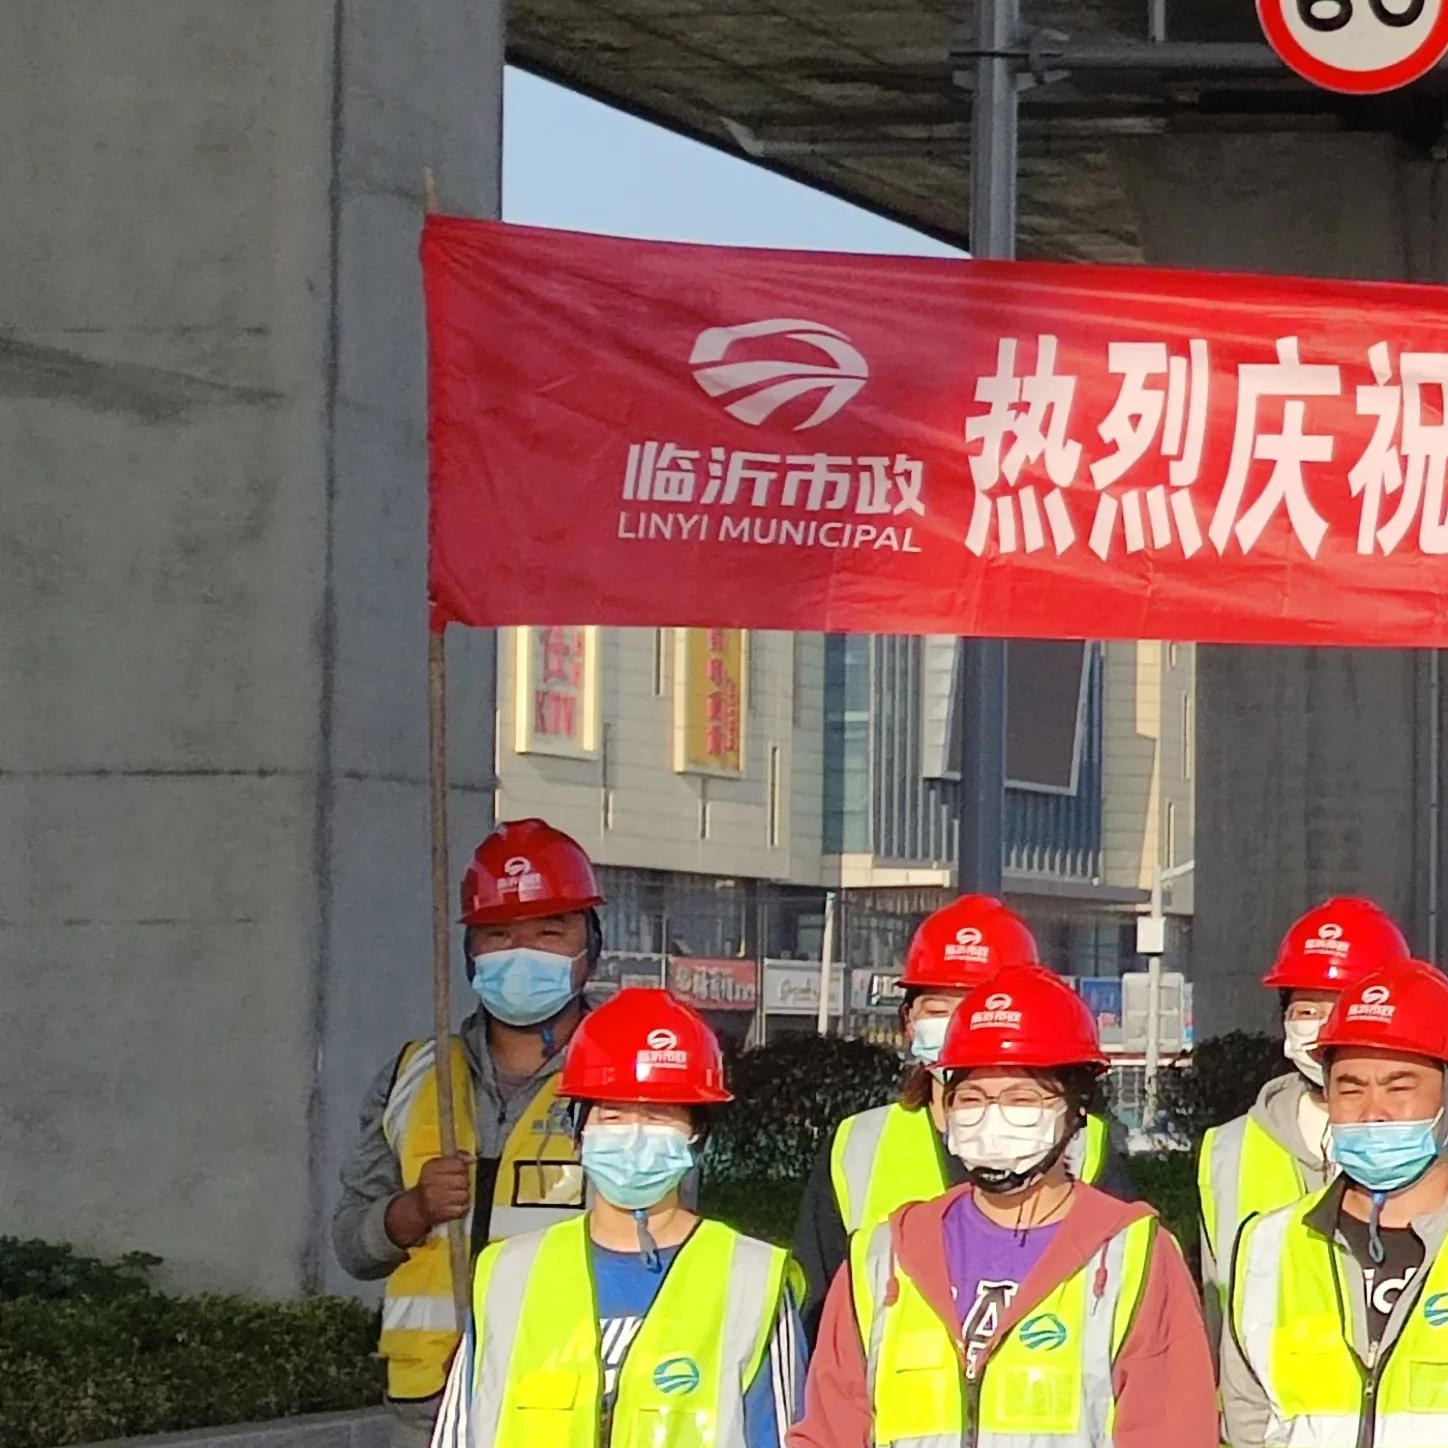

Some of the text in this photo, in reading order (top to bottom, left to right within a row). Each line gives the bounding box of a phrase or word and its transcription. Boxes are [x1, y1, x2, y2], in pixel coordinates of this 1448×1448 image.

[620, 439, 925, 517] 临沂市政
[617, 511, 922, 552] LINYI MUNICIPAL
[535, 690, 577, 738] KTV
